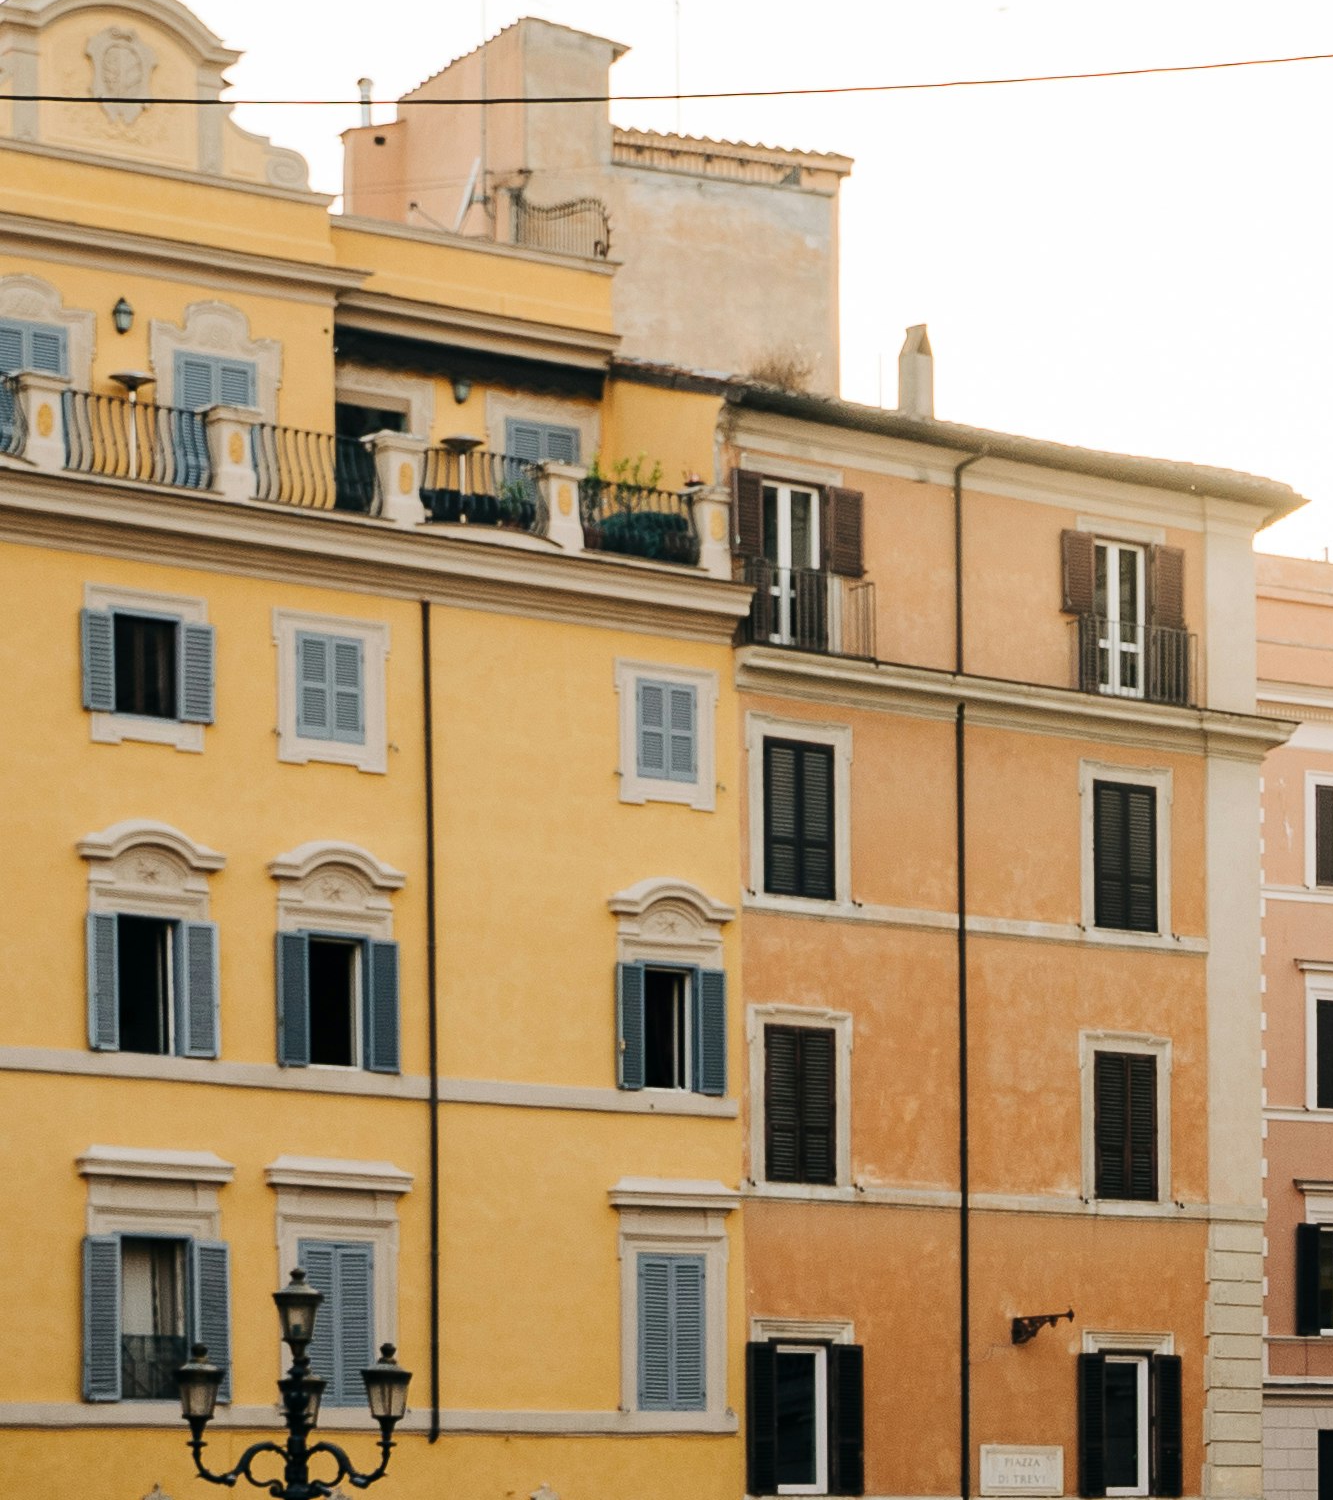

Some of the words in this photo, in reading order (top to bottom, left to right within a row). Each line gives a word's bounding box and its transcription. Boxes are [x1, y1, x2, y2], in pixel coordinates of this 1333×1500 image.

[1003, 1456, 1042, 1468] PIAZZA
[998, 1474, 1010, 1485] DI
[1013, 1474, 1047, 1485] TREVI
